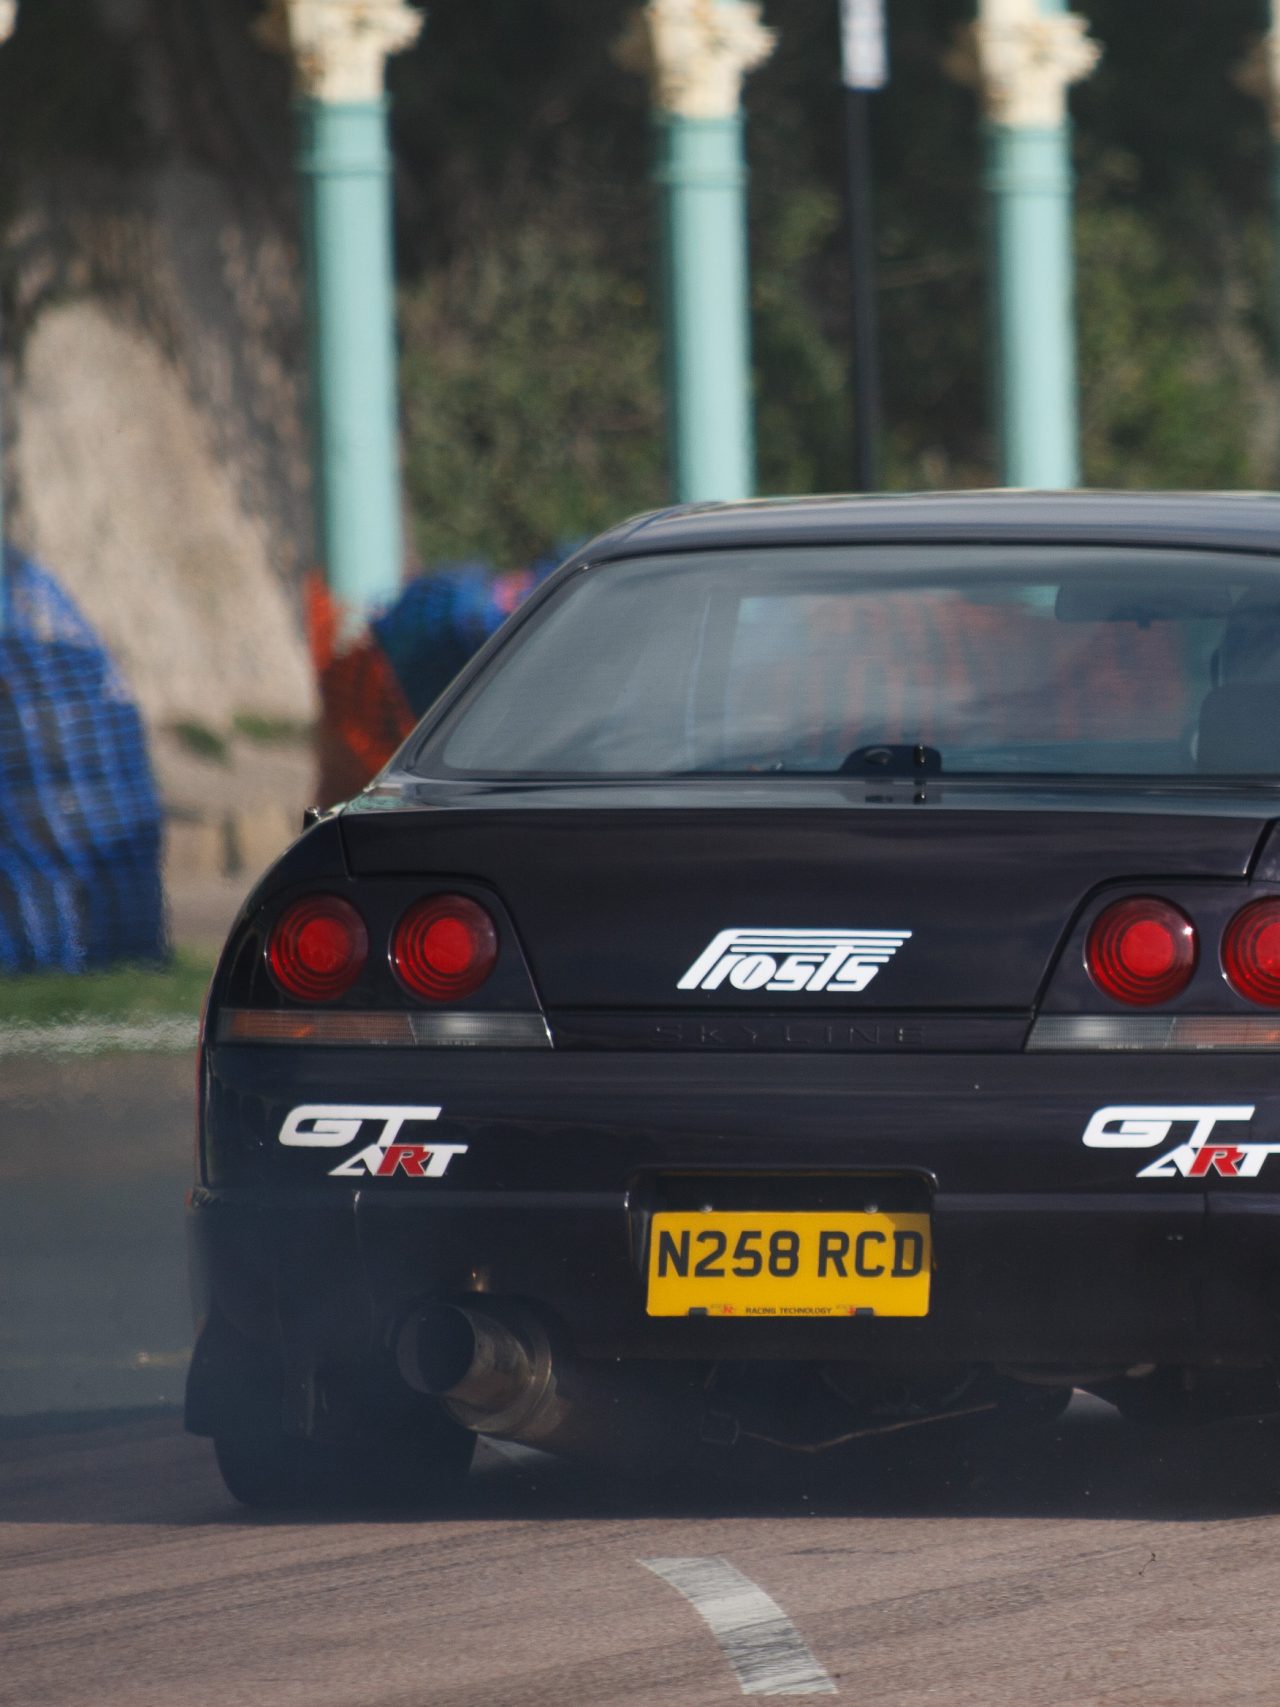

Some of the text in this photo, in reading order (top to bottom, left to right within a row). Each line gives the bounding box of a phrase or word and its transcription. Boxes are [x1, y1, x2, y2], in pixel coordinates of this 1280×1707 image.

[676, 928, 913, 992] Frosts
[649, 1025, 926, 1044] SKYLINE
[278, 1104, 442, 1147] GT
[1082, 1104, 1256, 1148] GT
[327, 1143, 469, 1178] ART
[657, 1230, 924, 1278] N258 RCD
[745, 1306, 776, 1314] RACING
[780, 1306, 832, 1314] TECHNOLOGY
